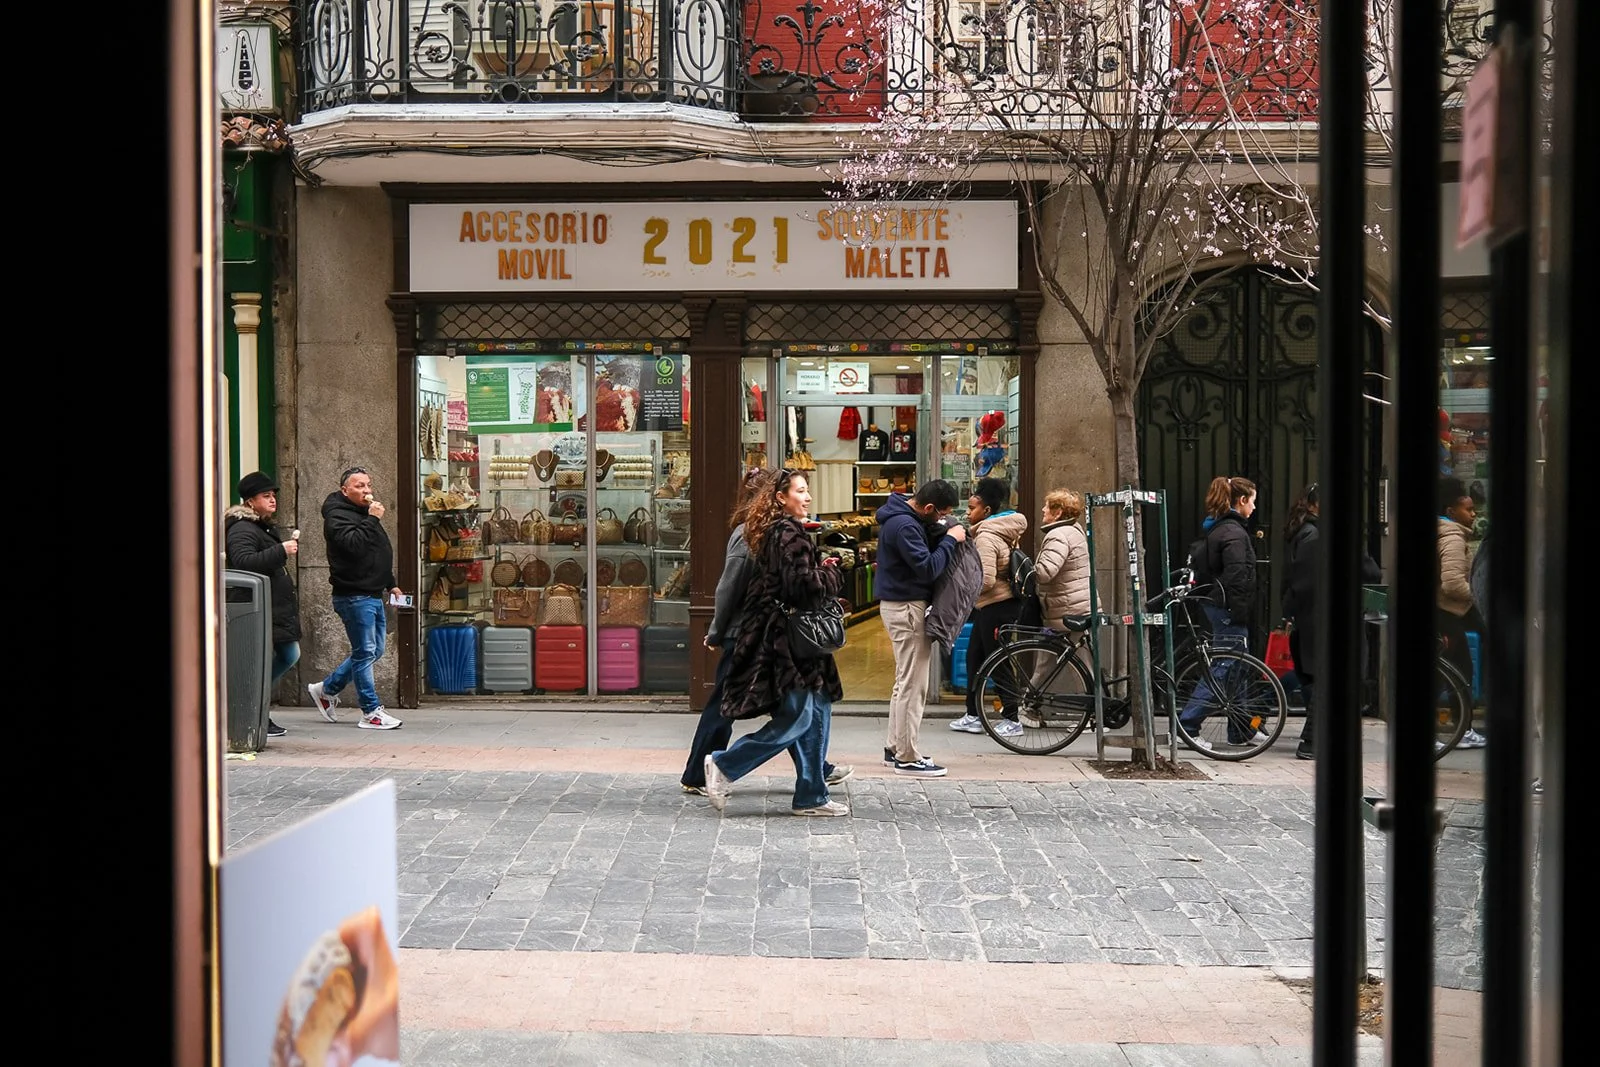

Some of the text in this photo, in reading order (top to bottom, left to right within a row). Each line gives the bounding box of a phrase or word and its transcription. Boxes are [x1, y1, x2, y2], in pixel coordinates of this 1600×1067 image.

[459, 211, 608, 244] ACCESORIO
[643, 216, 790, 265] 2021
[498, 249, 573, 281] MOVIL
[845, 246, 950, 279] MALETA
